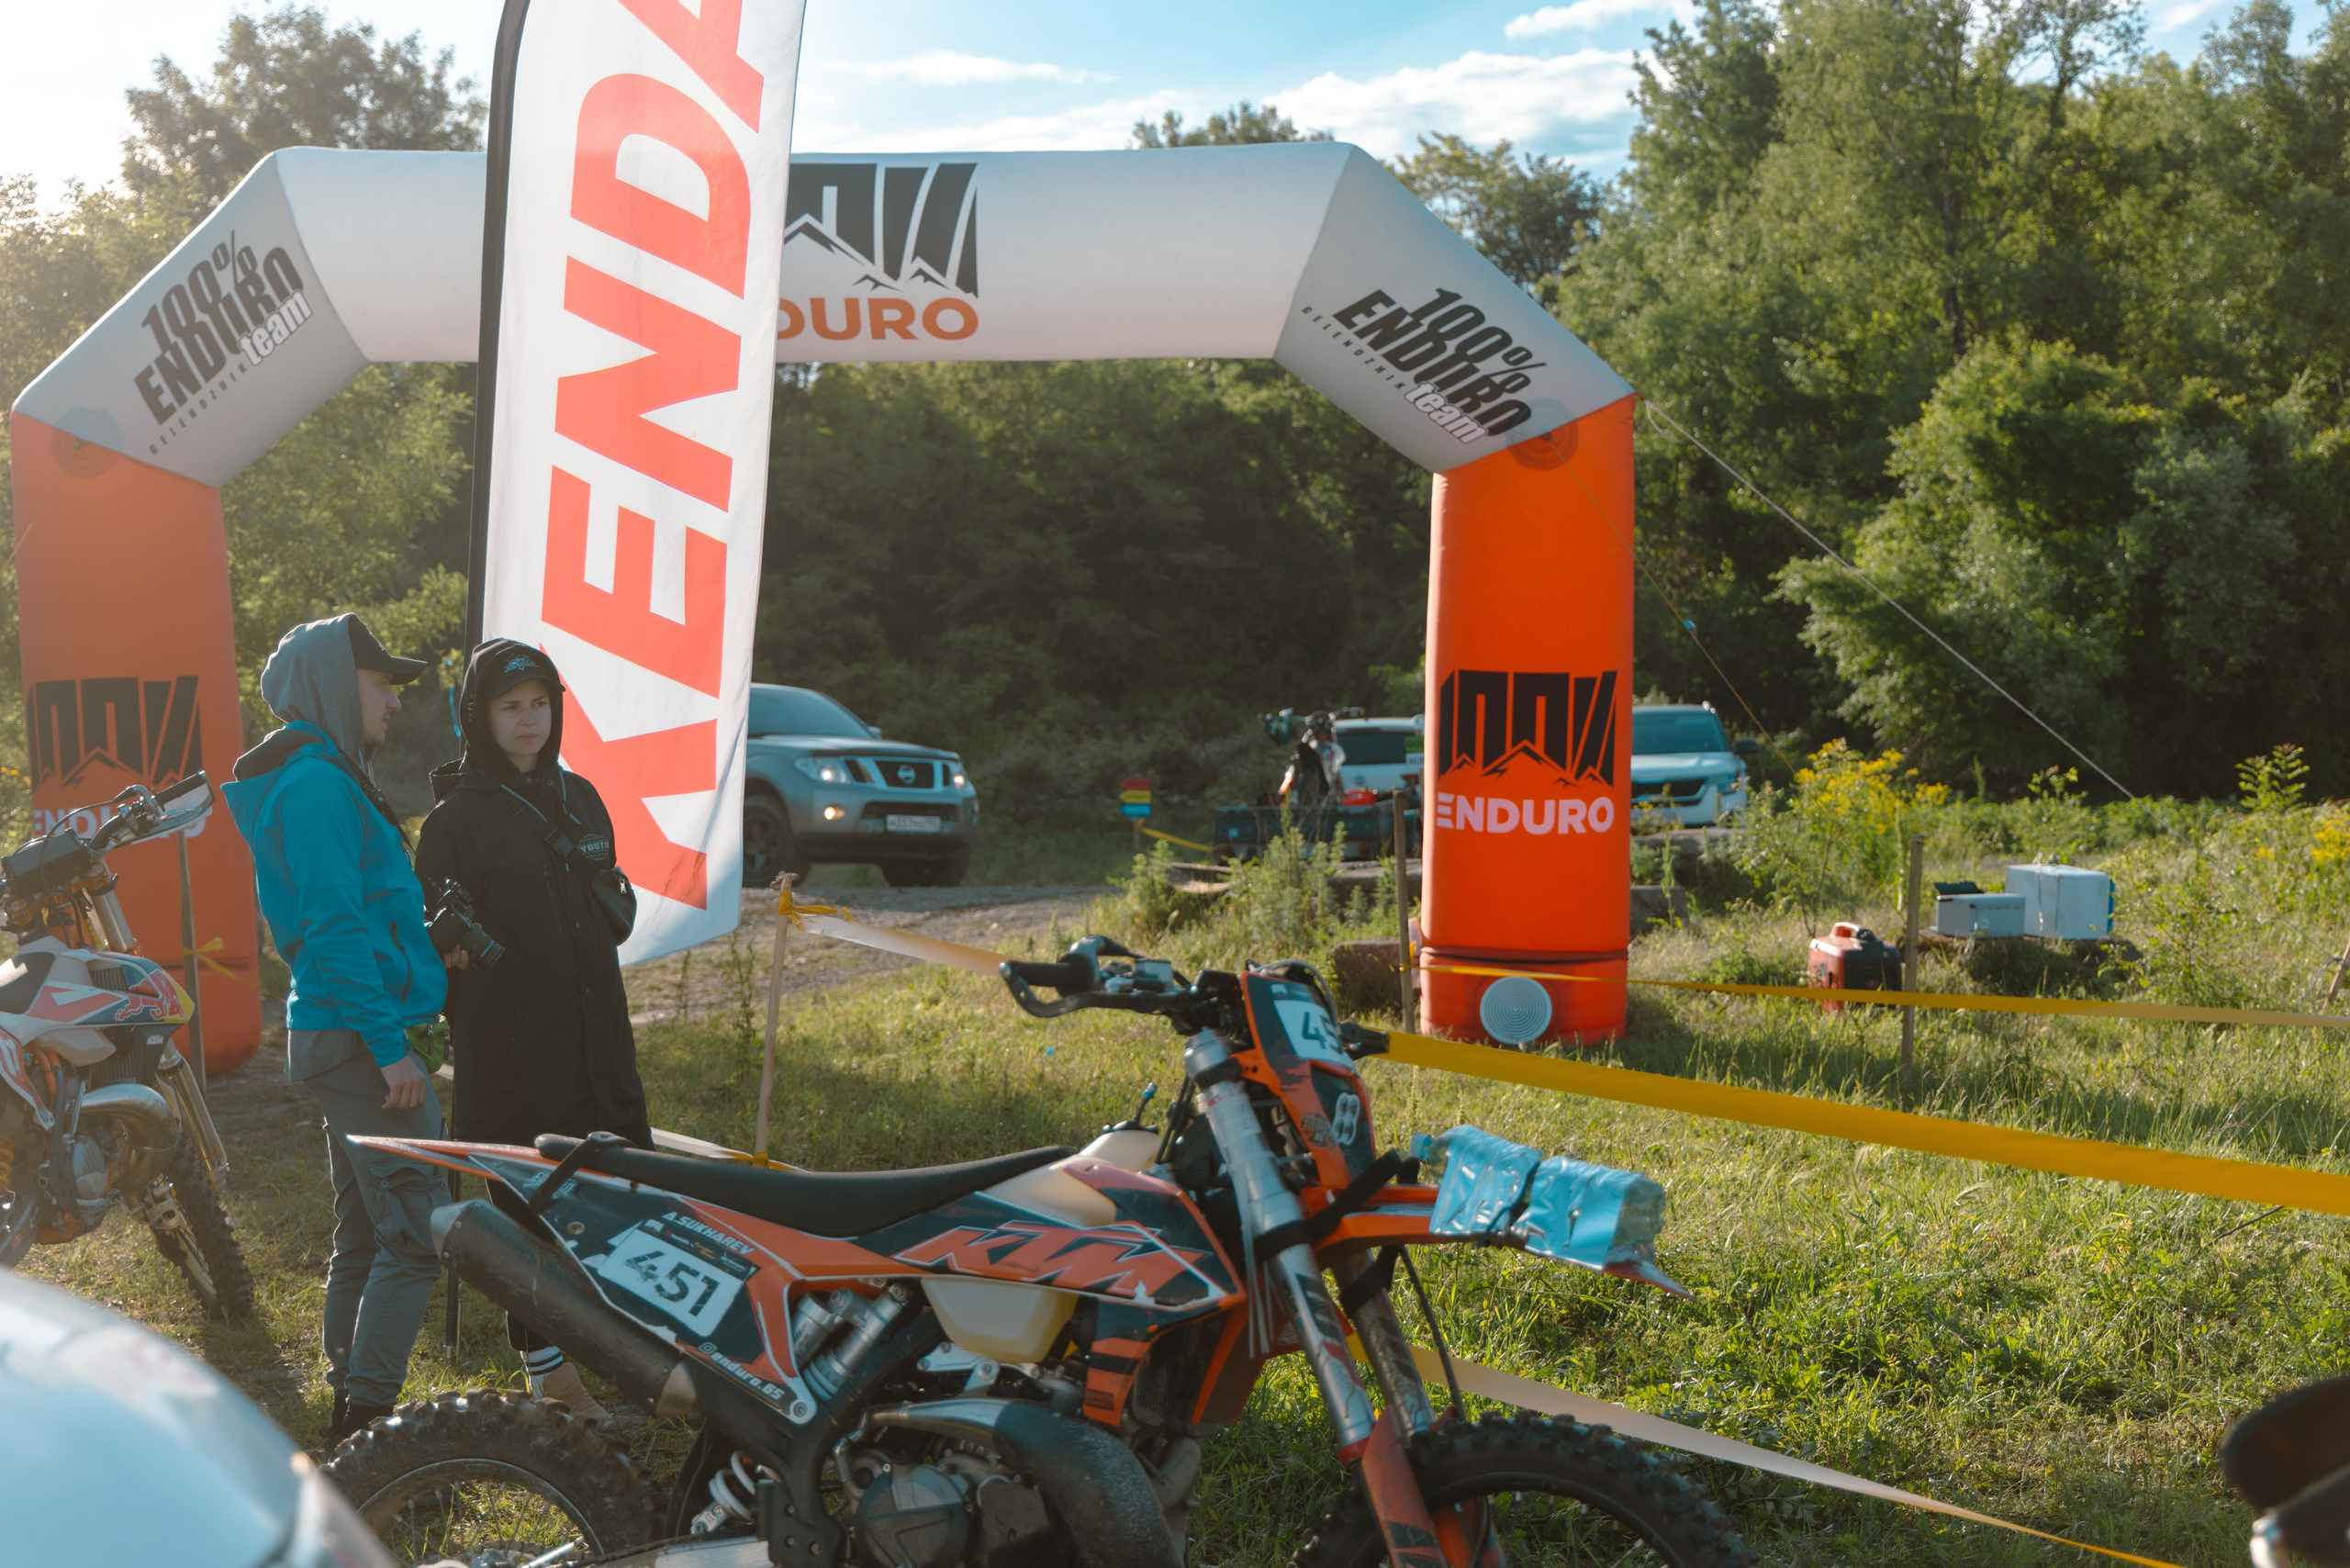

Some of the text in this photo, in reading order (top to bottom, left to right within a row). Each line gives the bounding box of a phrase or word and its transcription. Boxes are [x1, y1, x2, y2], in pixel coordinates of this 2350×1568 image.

[140, 229, 258, 351] 100%
[238, 289, 314, 366] team
[133, 247, 304, 426] ENDURO
[1302, 306, 1405, 390] GELENDZHIK
[1332, 289, 1532, 436] ENDURO
[1410, 287, 1548, 394] 100%
[149, 363, 248, 455] GELENDZHIK
[1404, 380, 1488, 444] team
[579, 841, 610, 853] YOUTH
[1437, 792, 1615, 835] ENDURO
[661, 1211, 757, 1256] A.SUKHAREV
[892, 1220, 1213, 1298] KTM
[625, 1249, 721, 1317] 451
[711, 1351, 785, 1400] enduro.65
